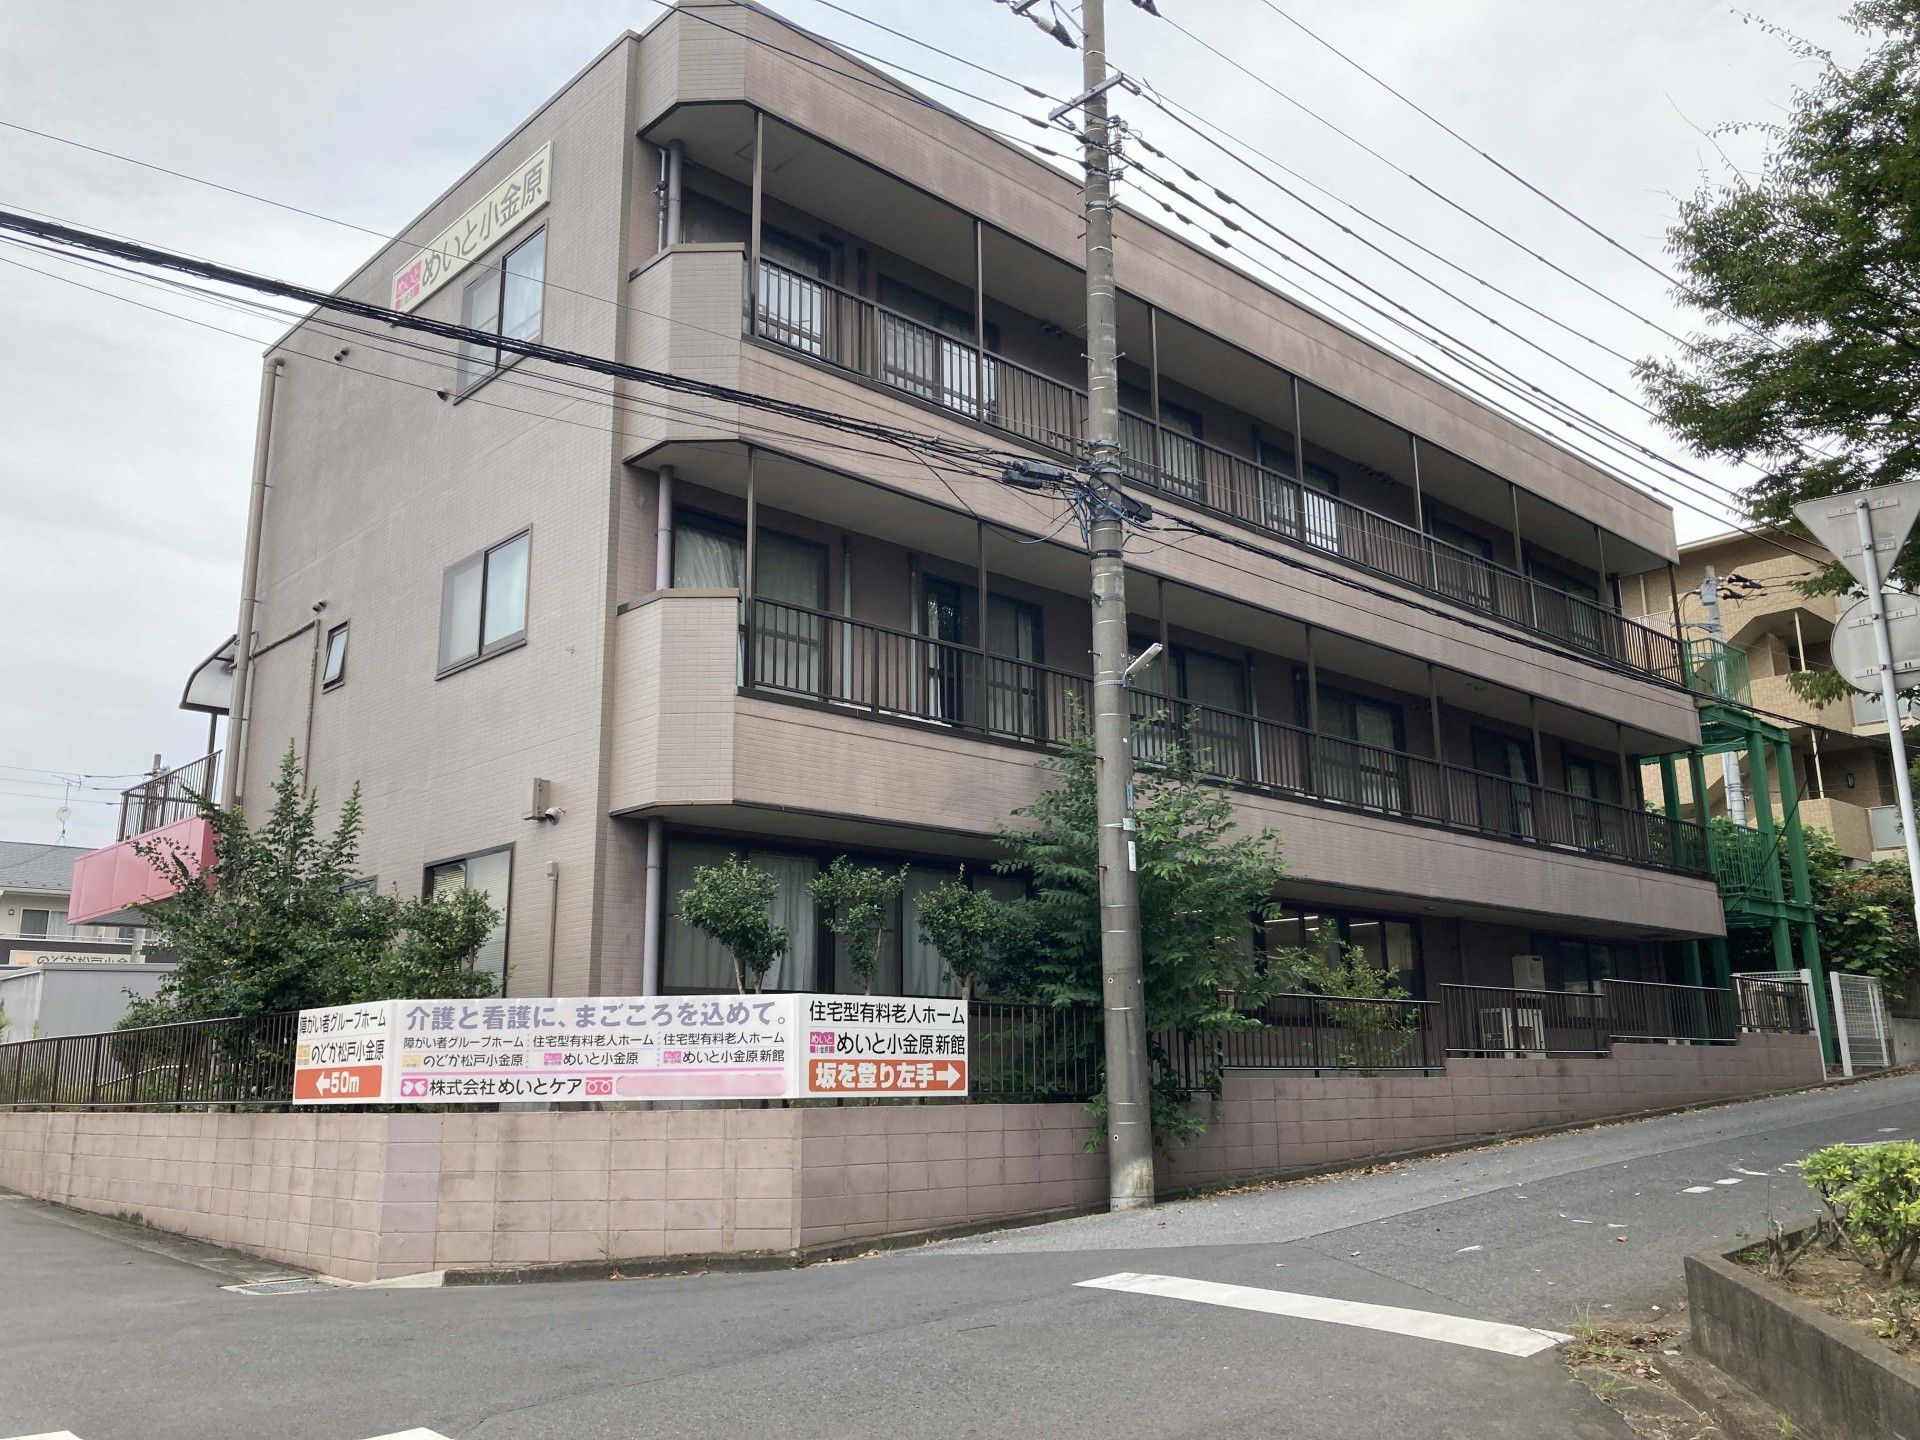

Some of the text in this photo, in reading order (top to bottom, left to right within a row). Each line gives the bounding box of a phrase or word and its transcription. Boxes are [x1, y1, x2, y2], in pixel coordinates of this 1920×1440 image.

[422, 159, 545, 287] めいと小金原
[299, 1008, 387, 1034] 障がい者グループホーム
[406, 1001, 787, 1031] 介護と看護に、まごころを込めて。
[809, 1000, 965, 1025] 住宅型有料老人ホーム
[403, 1035, 524, 1050] 障がい者グループホーム
[533, 1033, 654, 1049] 住宅型有料老人ホーム
[663, 1031, 785, 1046] 住宅型有料老人ホーム
[836, 1031, 966, 1055] めいと小金原新館
[311, 1039, 385, 1064] のどか松戸小金原
[423, 1053, 523, 1068] のどか松戸小金原
[563, 1050, 639, 1066] めいと小金原
[682, 1048, 785, 1064] めいと小金原新館
[329, 1071, 360, 1094] 50m
[815, 1061, 935, 1089] 坂を登り左手
[429, 1077, 583, 1097] 株式会社めいとケア
